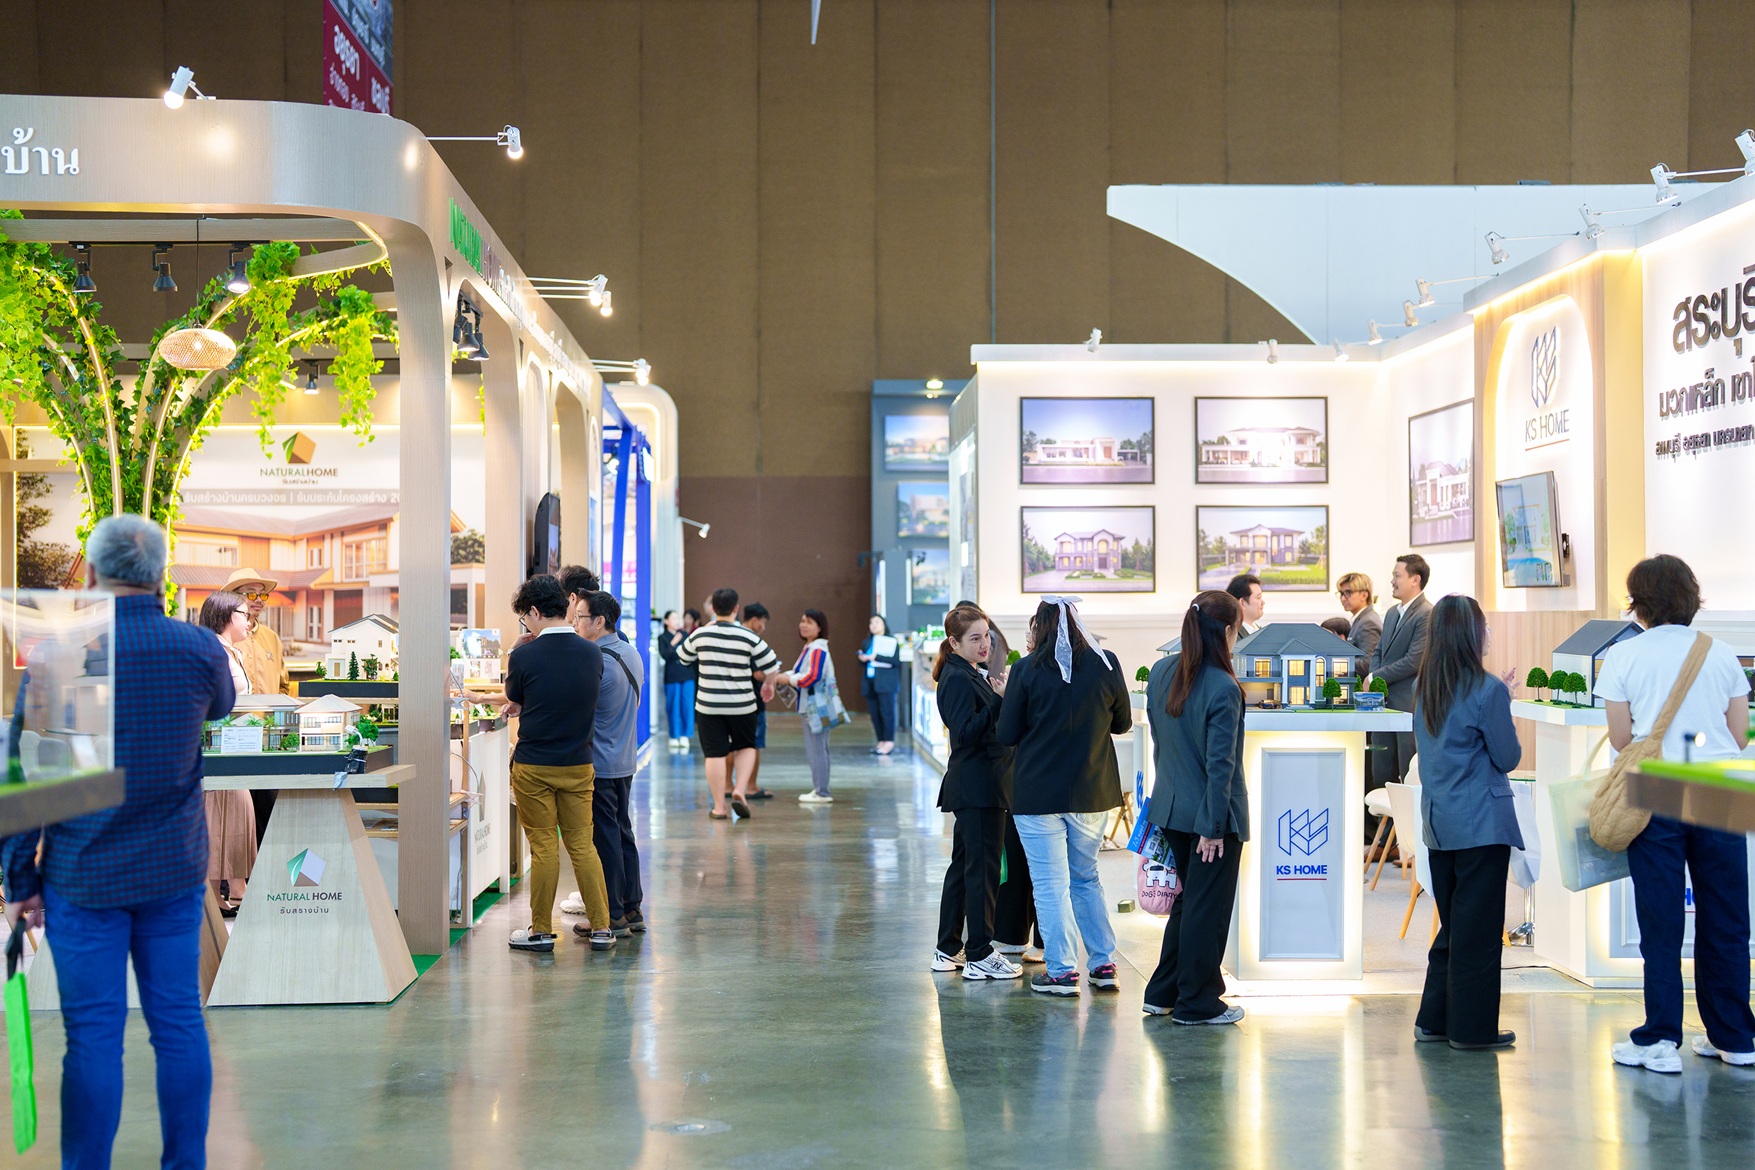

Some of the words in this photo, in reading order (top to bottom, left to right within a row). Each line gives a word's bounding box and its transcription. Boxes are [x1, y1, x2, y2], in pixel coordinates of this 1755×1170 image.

[1, 127, 80, 175] บ้าน
[1659, 367, 1725, 419] มวกเหล็ก
[1525, 418, 1537, 442] KS
[1539, 409, 1570, 438] HOME
[1276, 865, 1291, 875] KS
[1294, 864, 1327, 875] HOME
[267, 893, 310, 901] NATURAL
[312, 892, 342, 901] HOME
